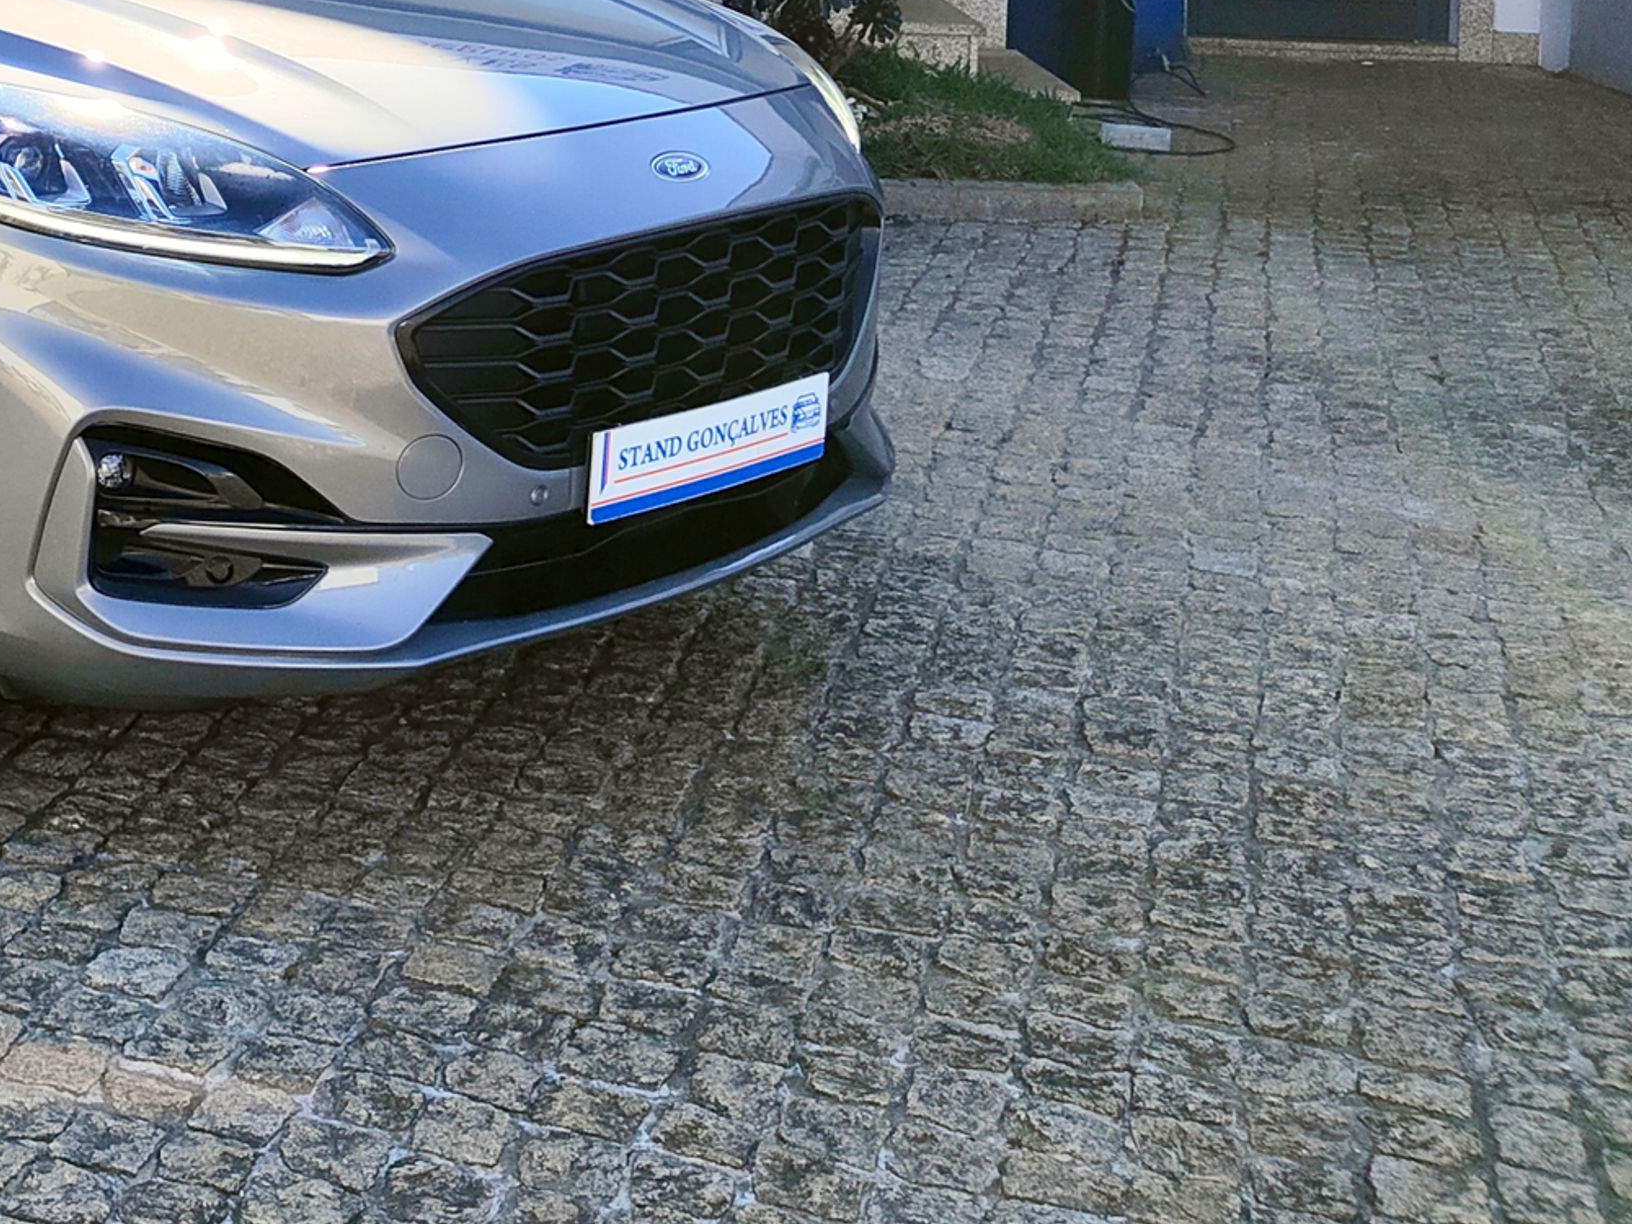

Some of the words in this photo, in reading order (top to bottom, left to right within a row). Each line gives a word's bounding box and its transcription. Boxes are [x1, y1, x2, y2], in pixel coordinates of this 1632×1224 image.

[664, 158, 698, 177] Ford
[618, 431, 683, 470] STAND
[686, 405, 789, 452] GONÇALVES
